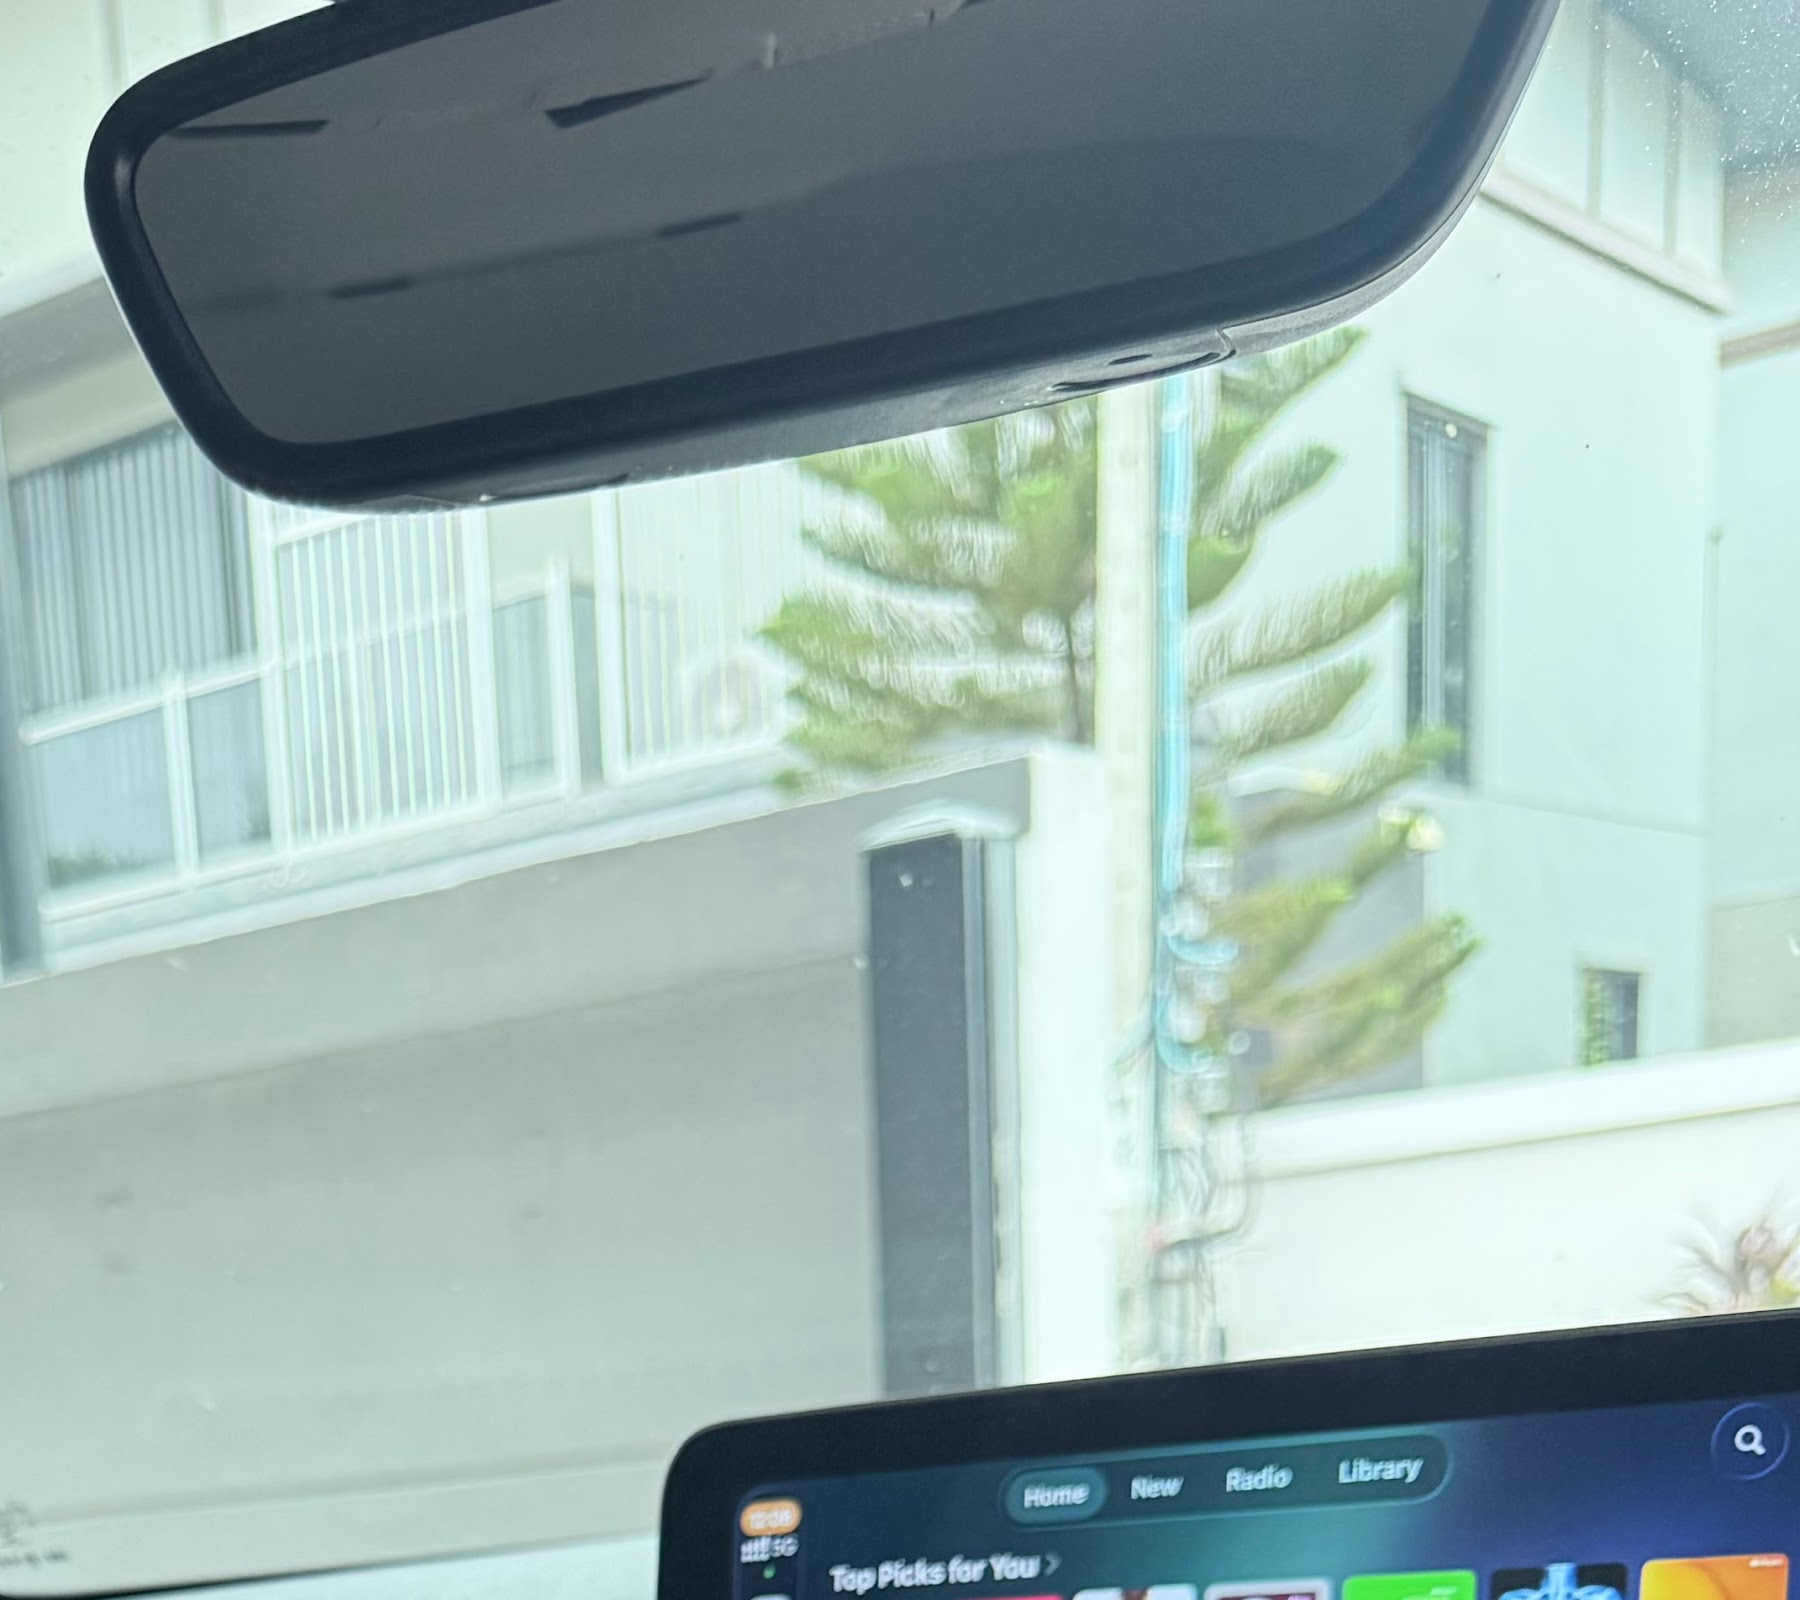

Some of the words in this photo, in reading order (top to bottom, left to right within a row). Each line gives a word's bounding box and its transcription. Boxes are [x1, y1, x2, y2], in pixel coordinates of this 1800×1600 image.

[1023, 1483, 1090, 1509] Home
[1130, 1475, 1184, 1500] New
[1226, 1464, 1293, 1492] Radio
[1338, 1456, 1425, 1485] Library
[829, 1563, 877, 1596] Top
[878, 1557, 948, 1590] Picks
[948, 1553, 989, 1584] for
[989, 1551, 1042, 1581] You
